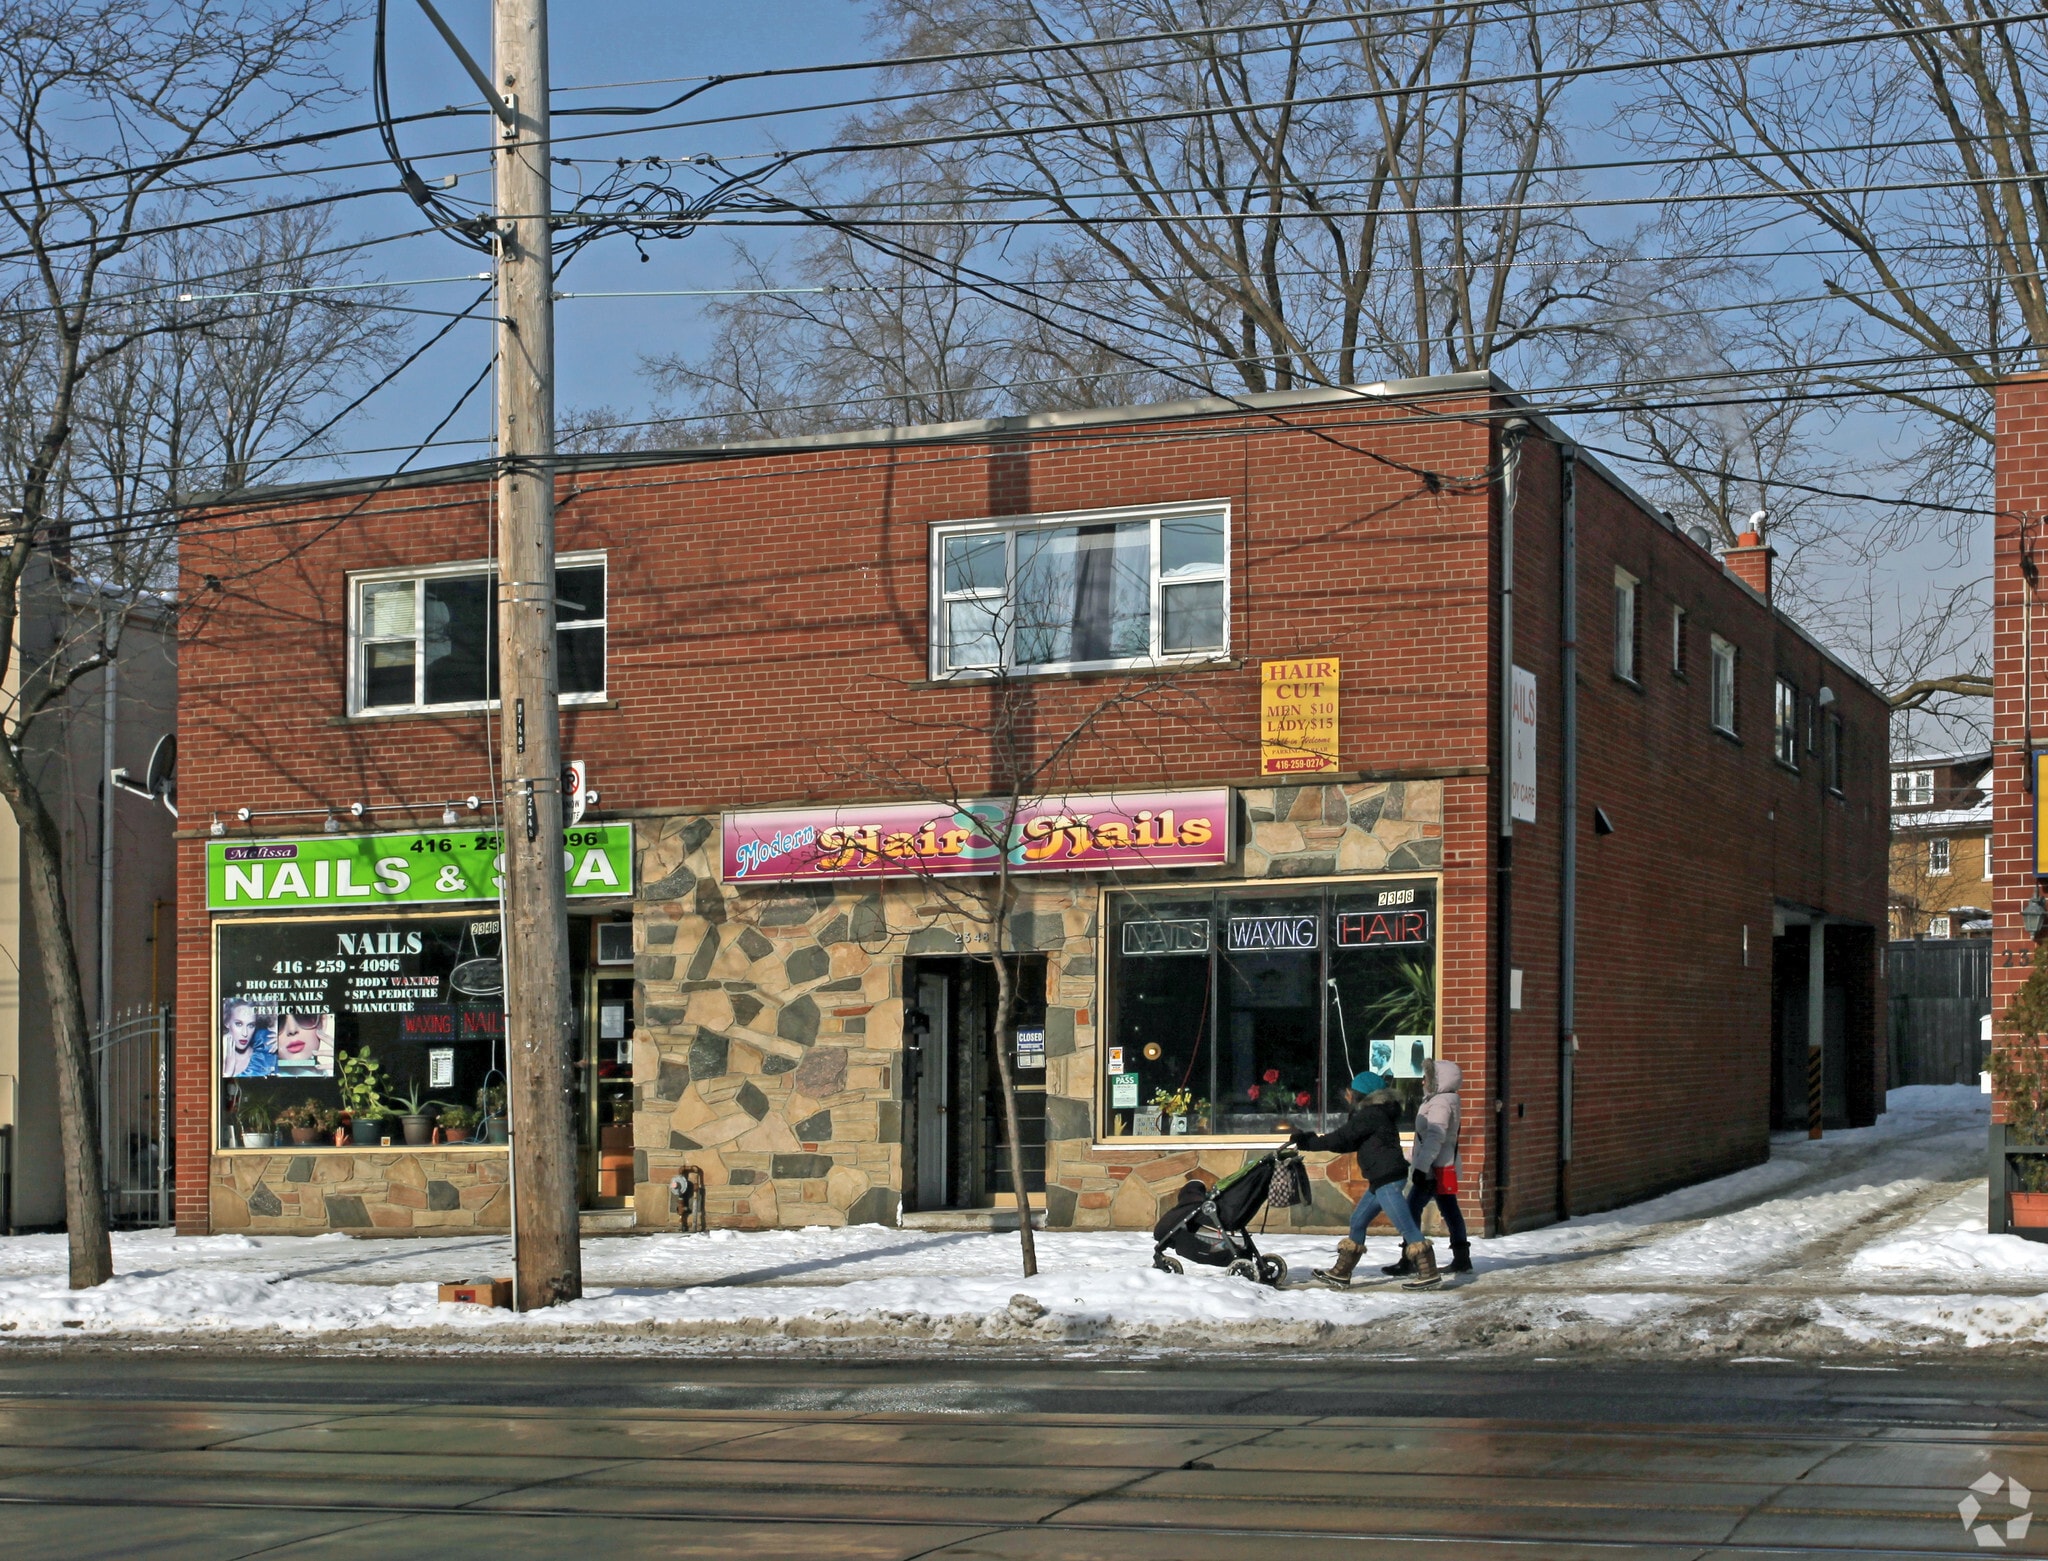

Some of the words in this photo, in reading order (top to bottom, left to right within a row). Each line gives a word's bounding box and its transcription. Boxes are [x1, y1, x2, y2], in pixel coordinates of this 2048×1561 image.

[1269, 662, 1332, 681] HAIR
[1276, 682, 1324, 699] CUT
[1267, 705, 1301, 717] MEN
[1311, 703, 1334, 715] $10
[1512, 682, 1535, 727] AILS
[1267, 719, 1306, 732] LADY
[1311, 718, 1333, 730] $15
[1275, 759, 1324, 770] 416-259-0274
[410, 838, 452, 853] 416
[474, 836, 504, 851] 25
[735, 825, 815, 879] Modern
[815, 820, 973, 873] Hair
[1021, 808, 1213, 862] Nails
[230, 848, 293, 859] Melissa
[224, 857, 411, 901] NAILS
[435, 864, 468, 892] &
[1378, 890, 1414, 905] 2348
[471, 921, 499, 934] 2348
[1233, 918, 1314, 947] WAXING
[1342, 913, 1424, 943] HAIR
[337, 931, 423, 956] NAILS
[955, 931, 990, 944] 2348
[1127, 923, 1204, 951] NAILS
[272, 960, 303, 974] 416
[315, 959, 346, 973] 259
[359, 959, 400, 972] 4096
[245, 980, 267, 990] BIO
[269, 980, 292, 989] GEL
[293, 978, 328, 989] NAILS
[355, 977, 389, 987] BODY
[391, 975, 440, 986] WAXING
[243, 992, 288, 1002] CALGEL
[289, 991, 324, 1002] NAILS
[352, 989, 376, 1000] SPA
[377, 987, 438, 999] PEDICURE
[251, 1005, 294, 1015] CRYLIC
[295, 1004, 330, 1015] NAILS
[352, 1001, 415, 1013] MANICURE
[405, 1015, 451, 1034] WAXING
[1019, 1032, 1043, 1042] CLOSED
[1115, 1076, 1135, 1085] PASS
